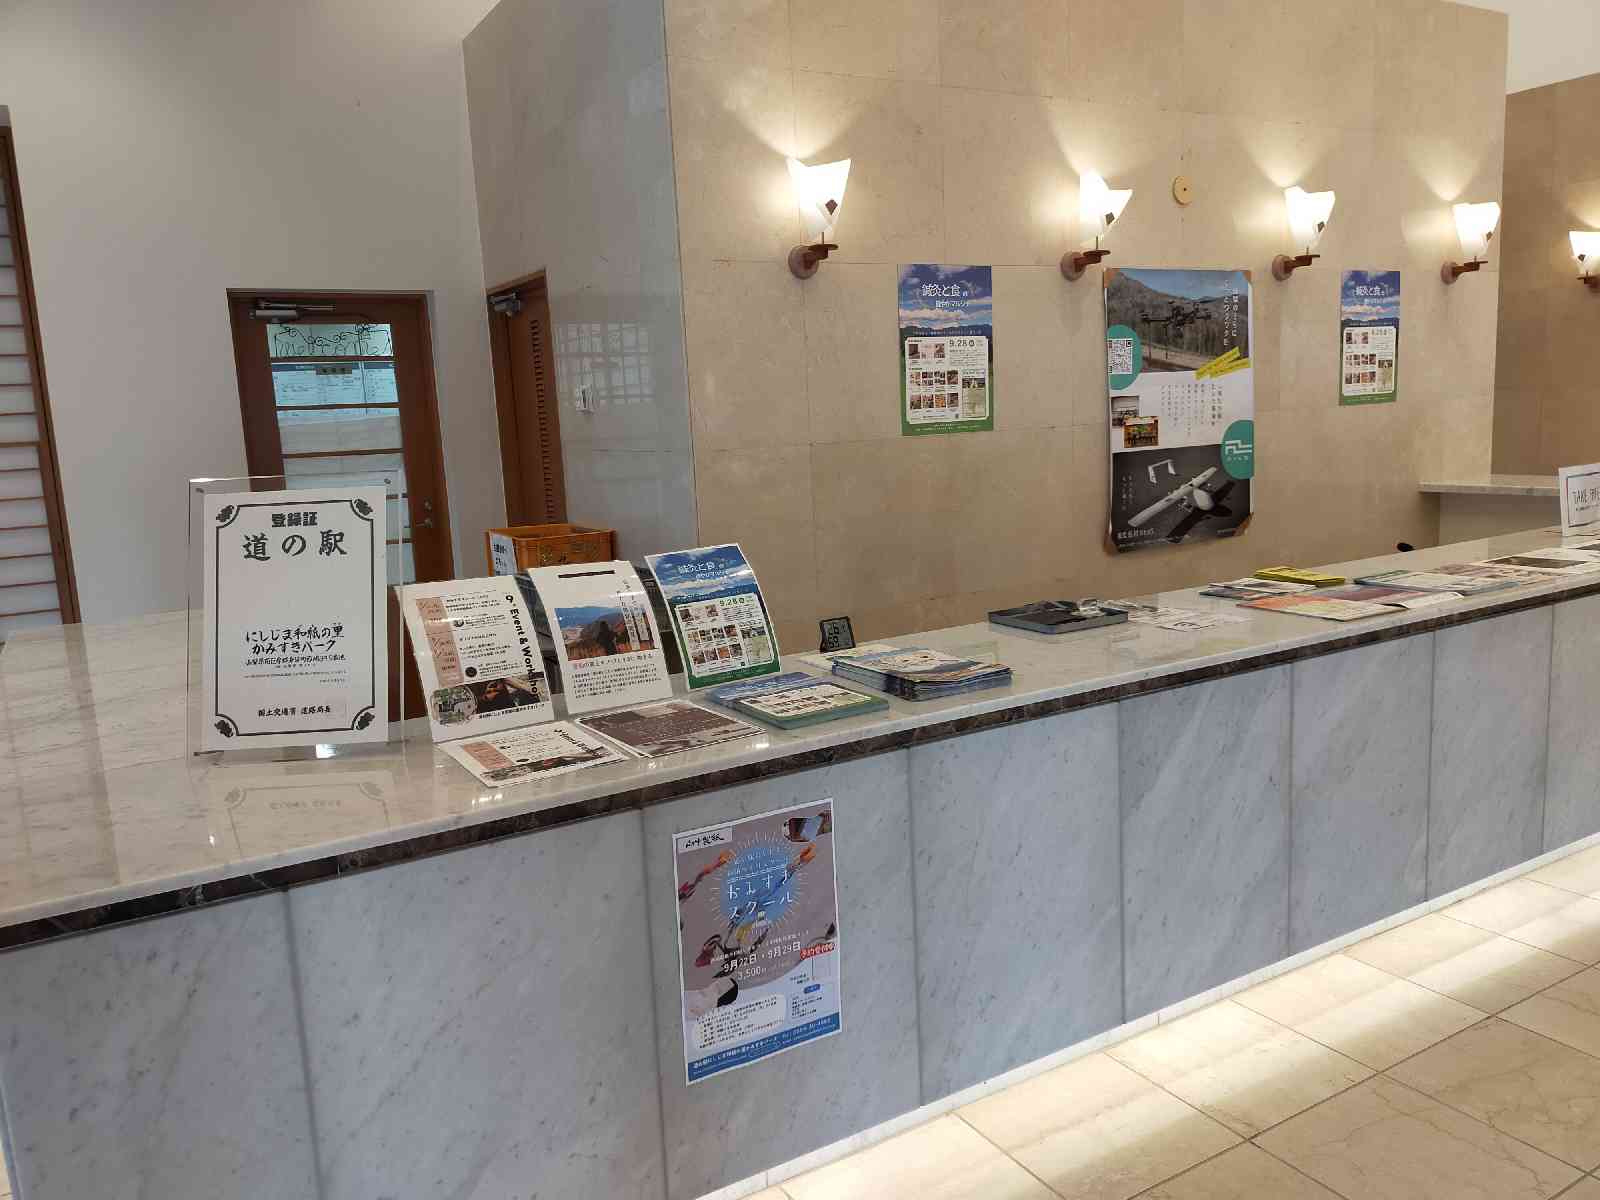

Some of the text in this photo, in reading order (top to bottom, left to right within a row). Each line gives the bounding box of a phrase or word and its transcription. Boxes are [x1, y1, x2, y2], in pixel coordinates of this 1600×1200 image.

[242, 529, 347, 561] 道の駅
[245, 623, 345, 643] にしじま和紙の里
[252, 639, 336, 655] かみすきパーク
[510, 608, 525, 636] Event
[522, 645, 540, 703] Workhop
[727, 891, 793, 919] スクール
